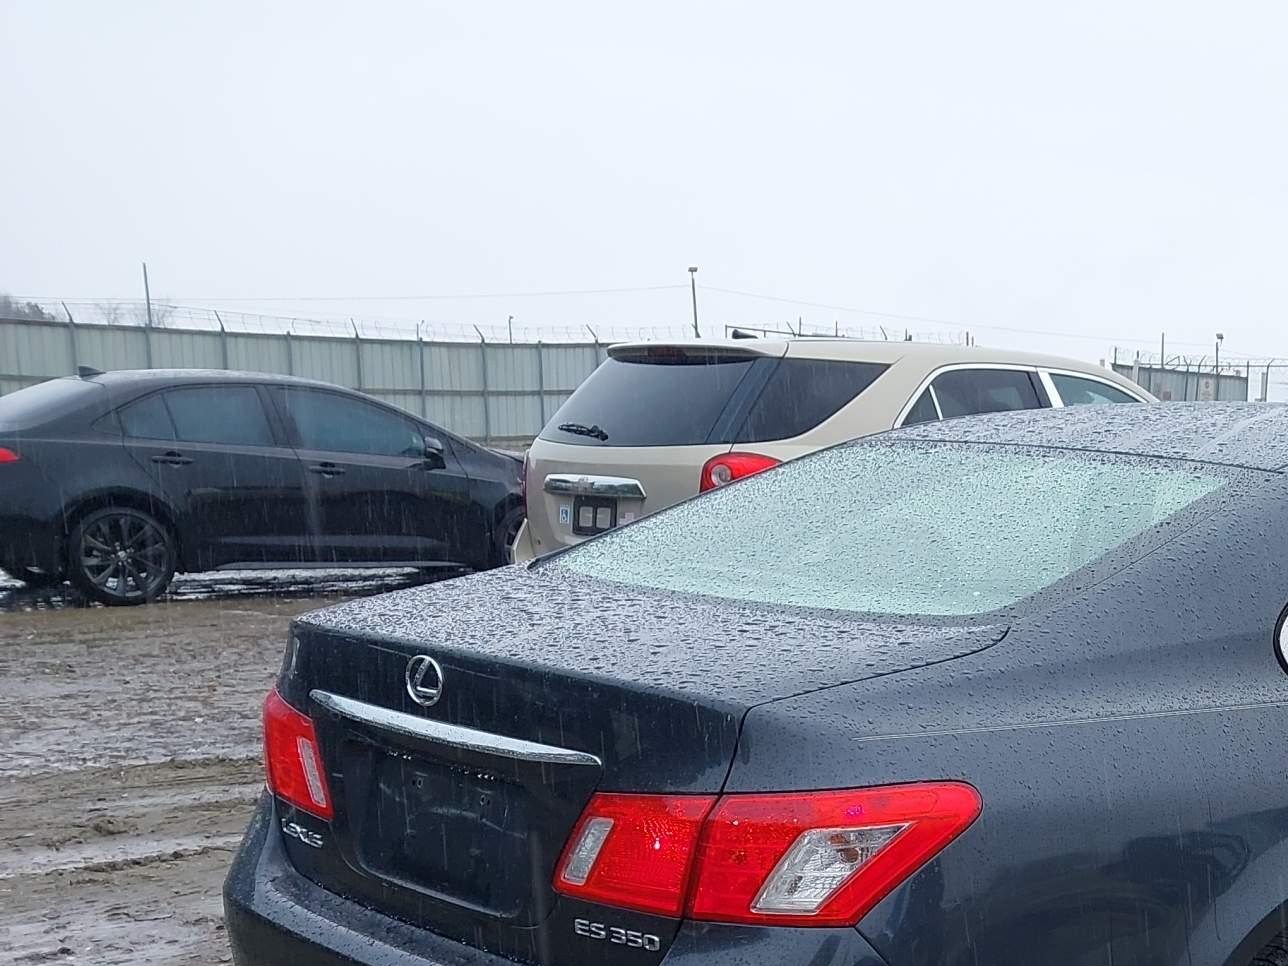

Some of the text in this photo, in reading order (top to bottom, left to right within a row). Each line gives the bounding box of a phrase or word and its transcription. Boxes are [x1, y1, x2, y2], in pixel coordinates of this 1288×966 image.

[281, 818, 324, 848] LEXUS
[574, 918, 660, 951] ES 350
